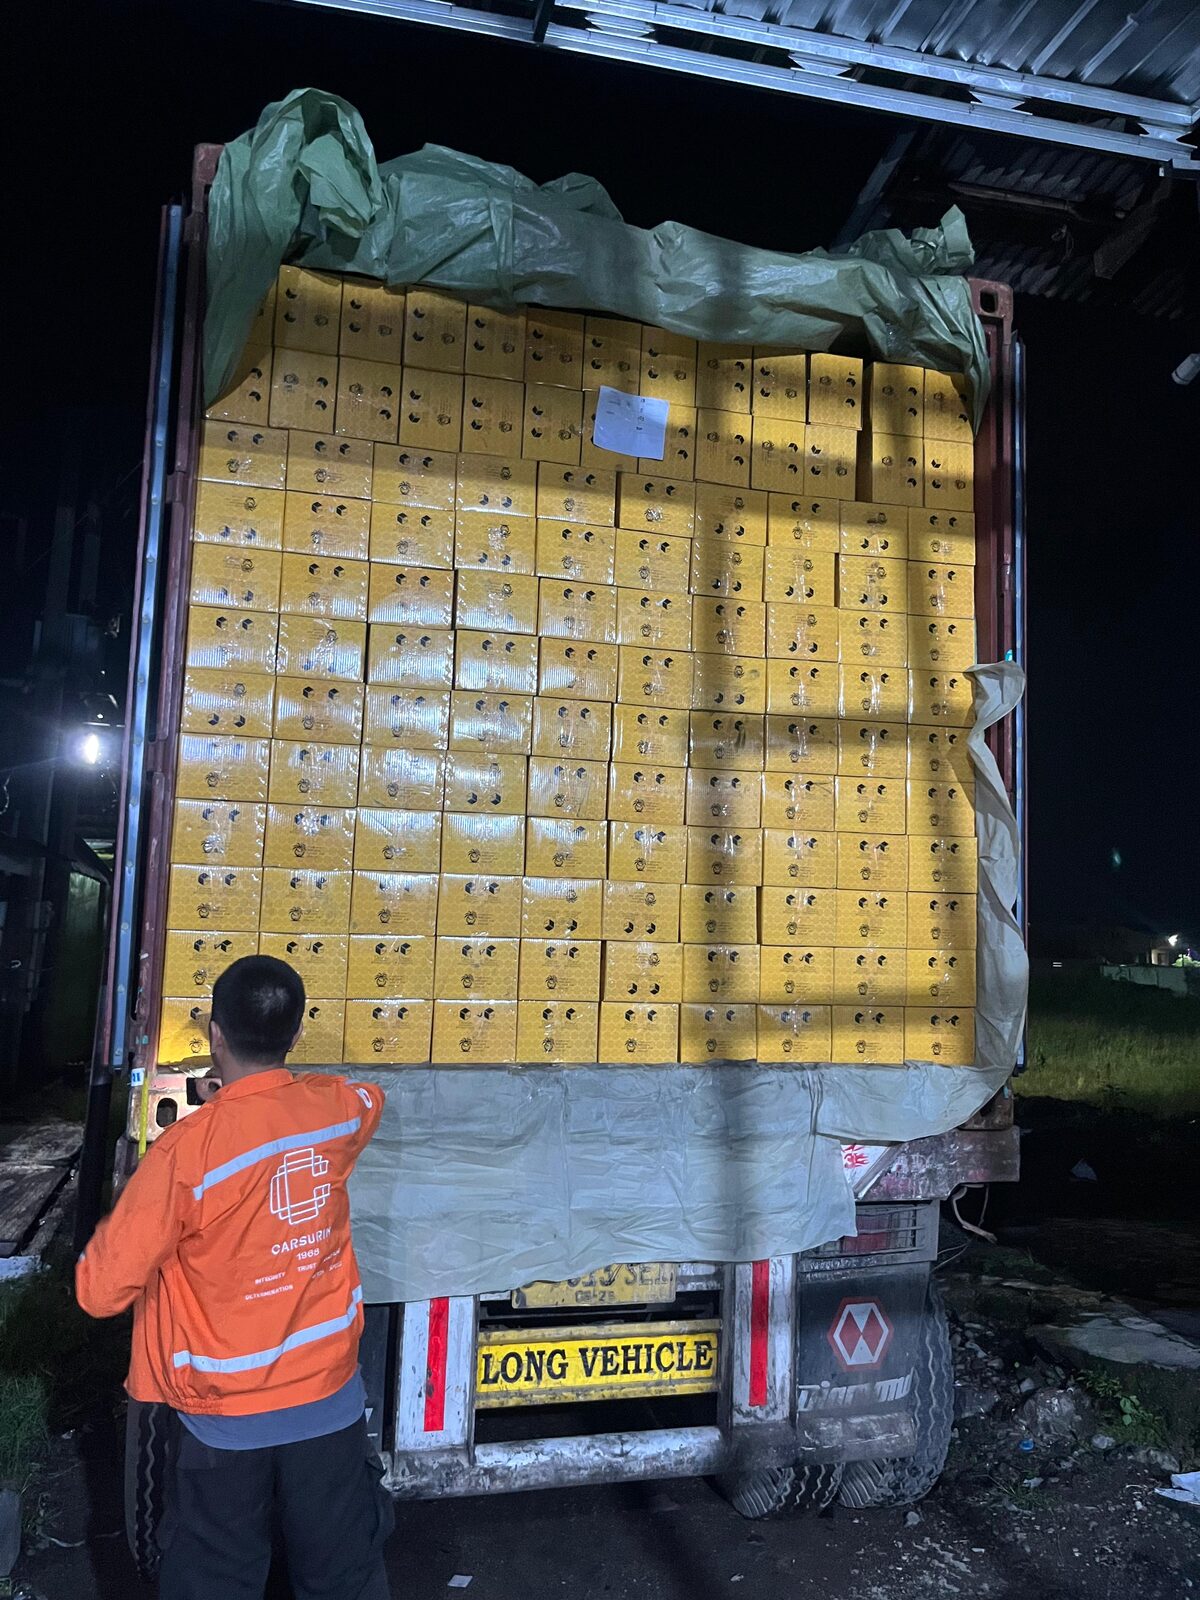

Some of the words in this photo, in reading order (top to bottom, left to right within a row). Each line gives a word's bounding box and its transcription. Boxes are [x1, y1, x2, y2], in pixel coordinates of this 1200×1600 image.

[296, 1247, 320, 1261] 1968
[481, 1348, 569, 1385] LONG
[579, 1340, 714, 1378] VEHICLE
